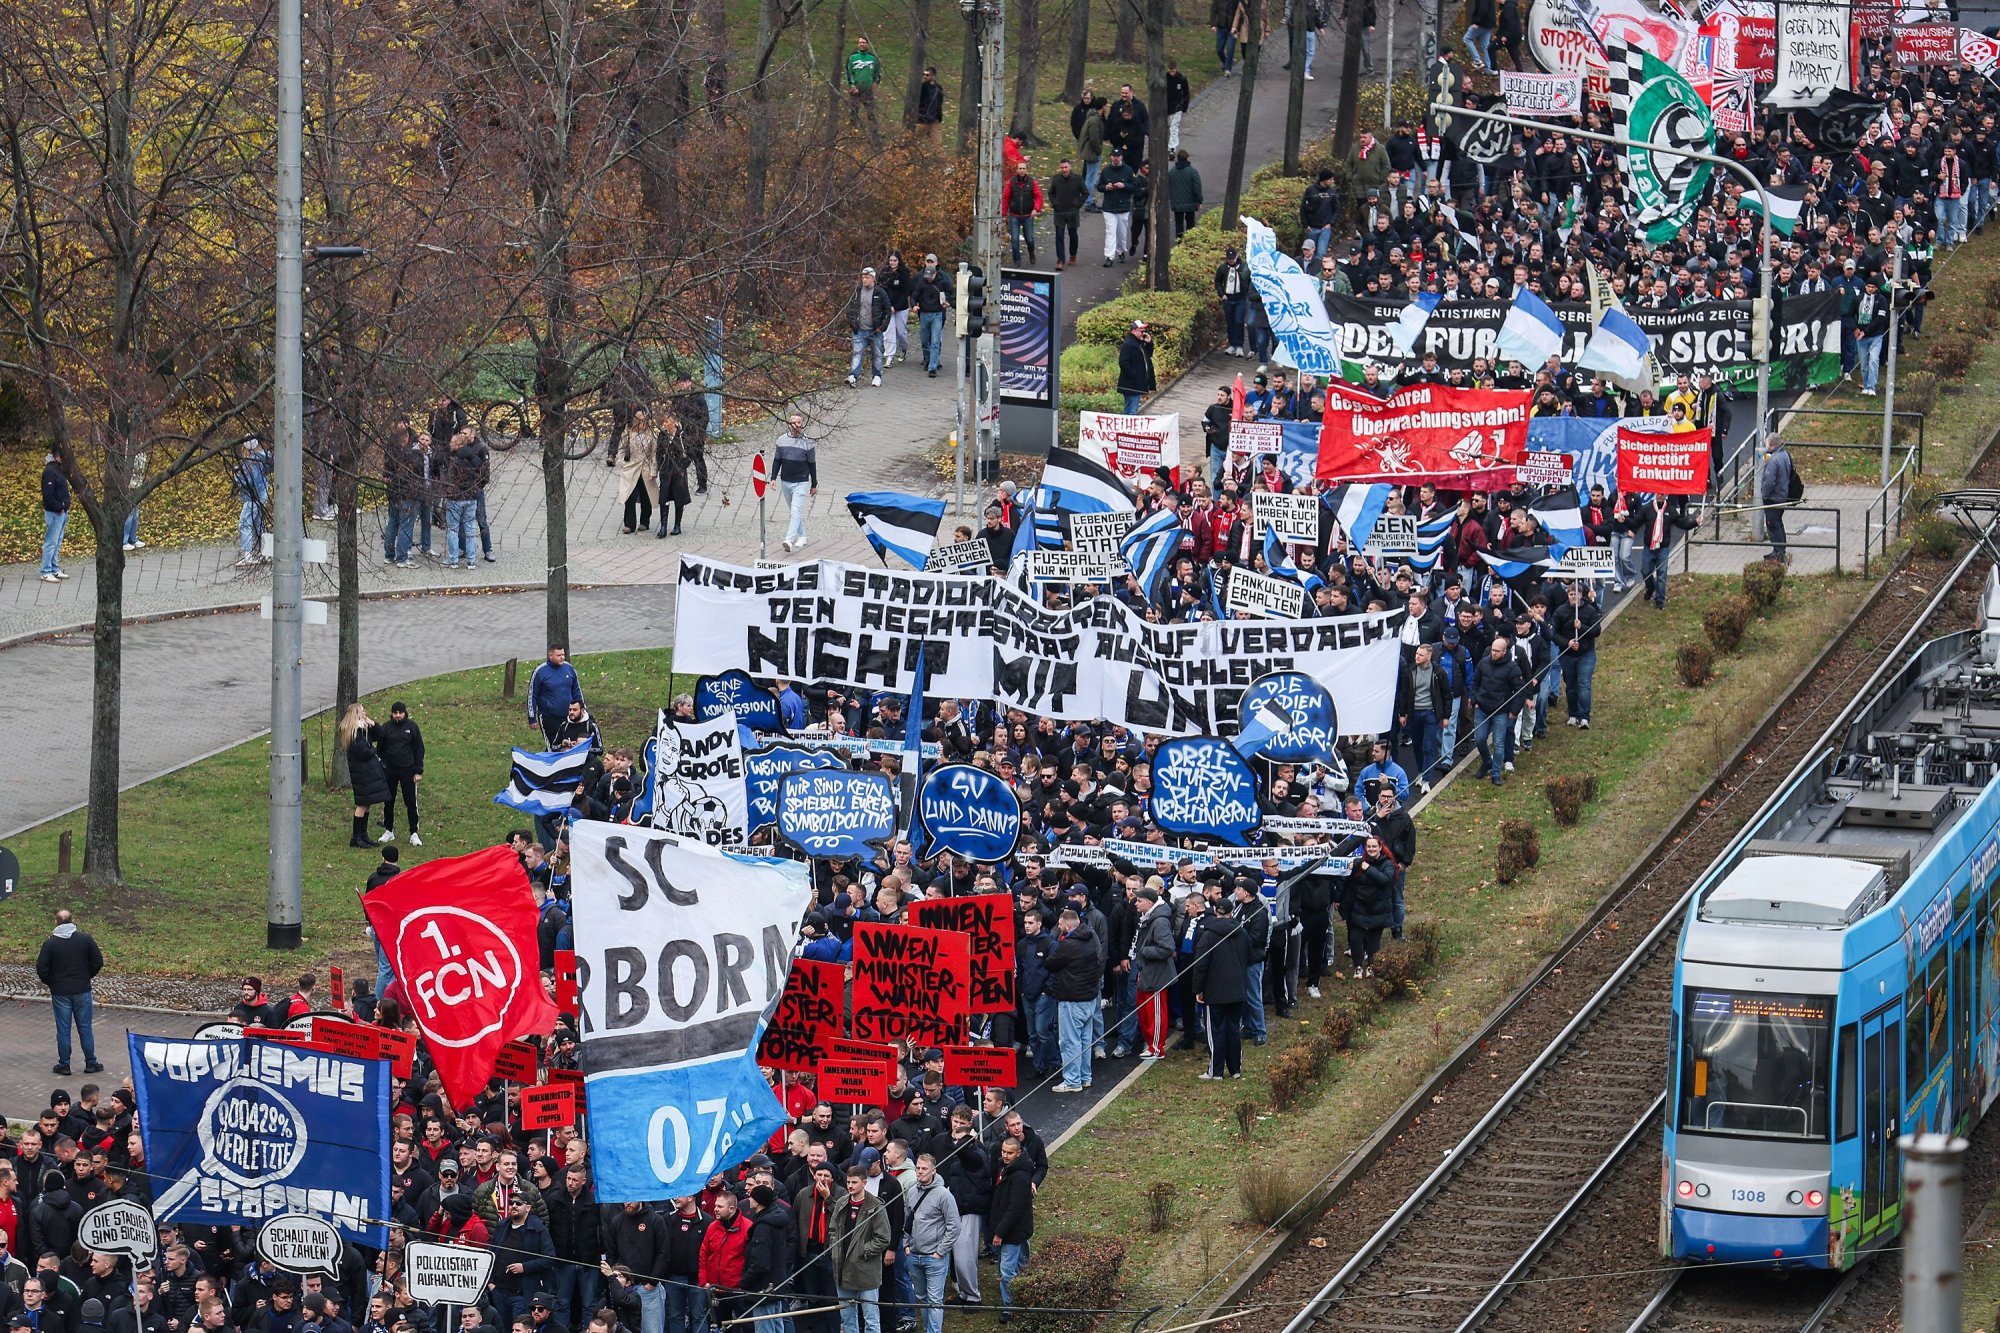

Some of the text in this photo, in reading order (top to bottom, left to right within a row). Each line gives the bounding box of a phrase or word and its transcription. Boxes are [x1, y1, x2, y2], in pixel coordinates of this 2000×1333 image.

[1785, 18, 1841, 38] GEGEN DEN
[1790, 41, 1840, 60] SICHERHEITS-
[1896, 39, 1958, 63] NEIN DANKE!
[1788, 60, 1832, 83] APPARAT
[1709, 310, 1750, 321] ZEIGE
[1352, 404, 1526, 437] Überwachungswahn!
[1620, 439, 1708, 453] Sicherheitswahn
[1526, 459, 1565, 469] BEACHTEN
[1529, 452, 1562, 462] FAKTEN
[1638, 452, 1690, 467] zerstört
[1518, 467, 1571, 478] POPULISMUS
[1526, 475, 1564, 484] STOPPEN
[1632, 467, 1695, 481] Fankultur
[1297, 499, 1317, 509] WIR
[1073, 512, 1133, 525] LEBENDIGE
[1256, 508, 1317, 521] HABEN EUCH
[1276, 520, 1317, 536] BLICK!
[1374, 517, 1415, 533] GEN
[941, 541, 985, 558] STADIEN
[1076, 538, 1122, 553] STAT
[949, 551, 989, 567] SICHER!
[1033, 552, 1106, 566] FUSSBALL
[1034, 566, 1107, 576] NUR MIT UNS!
[1233, 573, 1301, 600] FANKULTUR
[678, 560, 819, 594] MITTELS
[1141, 624, 1199, 658] AUF
[1220, 612, 1402, 656] VERDACHT
[1231, 586, 1300, 616] ERHALTEN!
[768, 598, 835, 625] DEN
[747, 625, 951, 692] NICHT
[994, 645, 1078, 713] MIT
[705, 677, 744, 694] KEINE
[1259, 676, 1304, 695] DIE
[680, 729, 735, 758] ANDY
[677, 754, 741, 780] GROTE
[750, 759, 793, 775] WENN
[952, 773, 988, 800] SV
[1157, 765, 1251, 792] STUFEN-
[785, 795, 892, 815] SPIELBALL EURER
[1169, 784, 1229, 807] PLAN
[782, 810, 893, 834] SYMBOLPOLITIK
[926, 797, 1018, 836] UND DANN?
[1152, 797, 1258, 828] VERHINDERN!
[1263, 818, 1322, 830] POPULISMUS
[705, 827, 744, 846] DES
[1059, 844, 1107, 859] POPULISM
[1104, 840, 1163, 858] POPULISMUS
[1168, 850, 1214, 865] STOPPEN!
[605, 836, 699, 911] SC
[420, 920, 462, 960] 1.
[415, 949, 508, 1019] FCN
[855, 959, 966, 1000] MINISTER-
[870, 983, 939, 1016] WAHN
[855, 1006, 968, 1047] STOPPEN!
[833, 1045, 896, 1059] INNENMINISTER-
[143, 1042, 366, 1102] POPULISMUS
[824, 1065, 885, 1077] INNENMINISTER-
[841, 1077, 864, 1086] WAHN
[834, 1087, 867, 1098] STOPPEN
[541, 1103, 559, 1112] WAHN
[536, 1114, 560, 1124] STOPPEN
[216, 1127, 294, 1170] VERLETZTE
[648, 1098, 728, 1184] 07
[200, 1176, 369, 1234] STOPPEN!
[1730, 1188, 1767, 1203] 1308
[93, 1211, 149, 1229] DIE STADIEN
[92, 1228, 118, 1245] SIND
[270, 1228, 330, 1245] SCHAUT AUF
[272, 1243, 289, 1259] DIE
[416, 1254, 479, 1273] POLIZEISTAAT
[417, 1271, 478, 1291] AUFHALTEN!!
